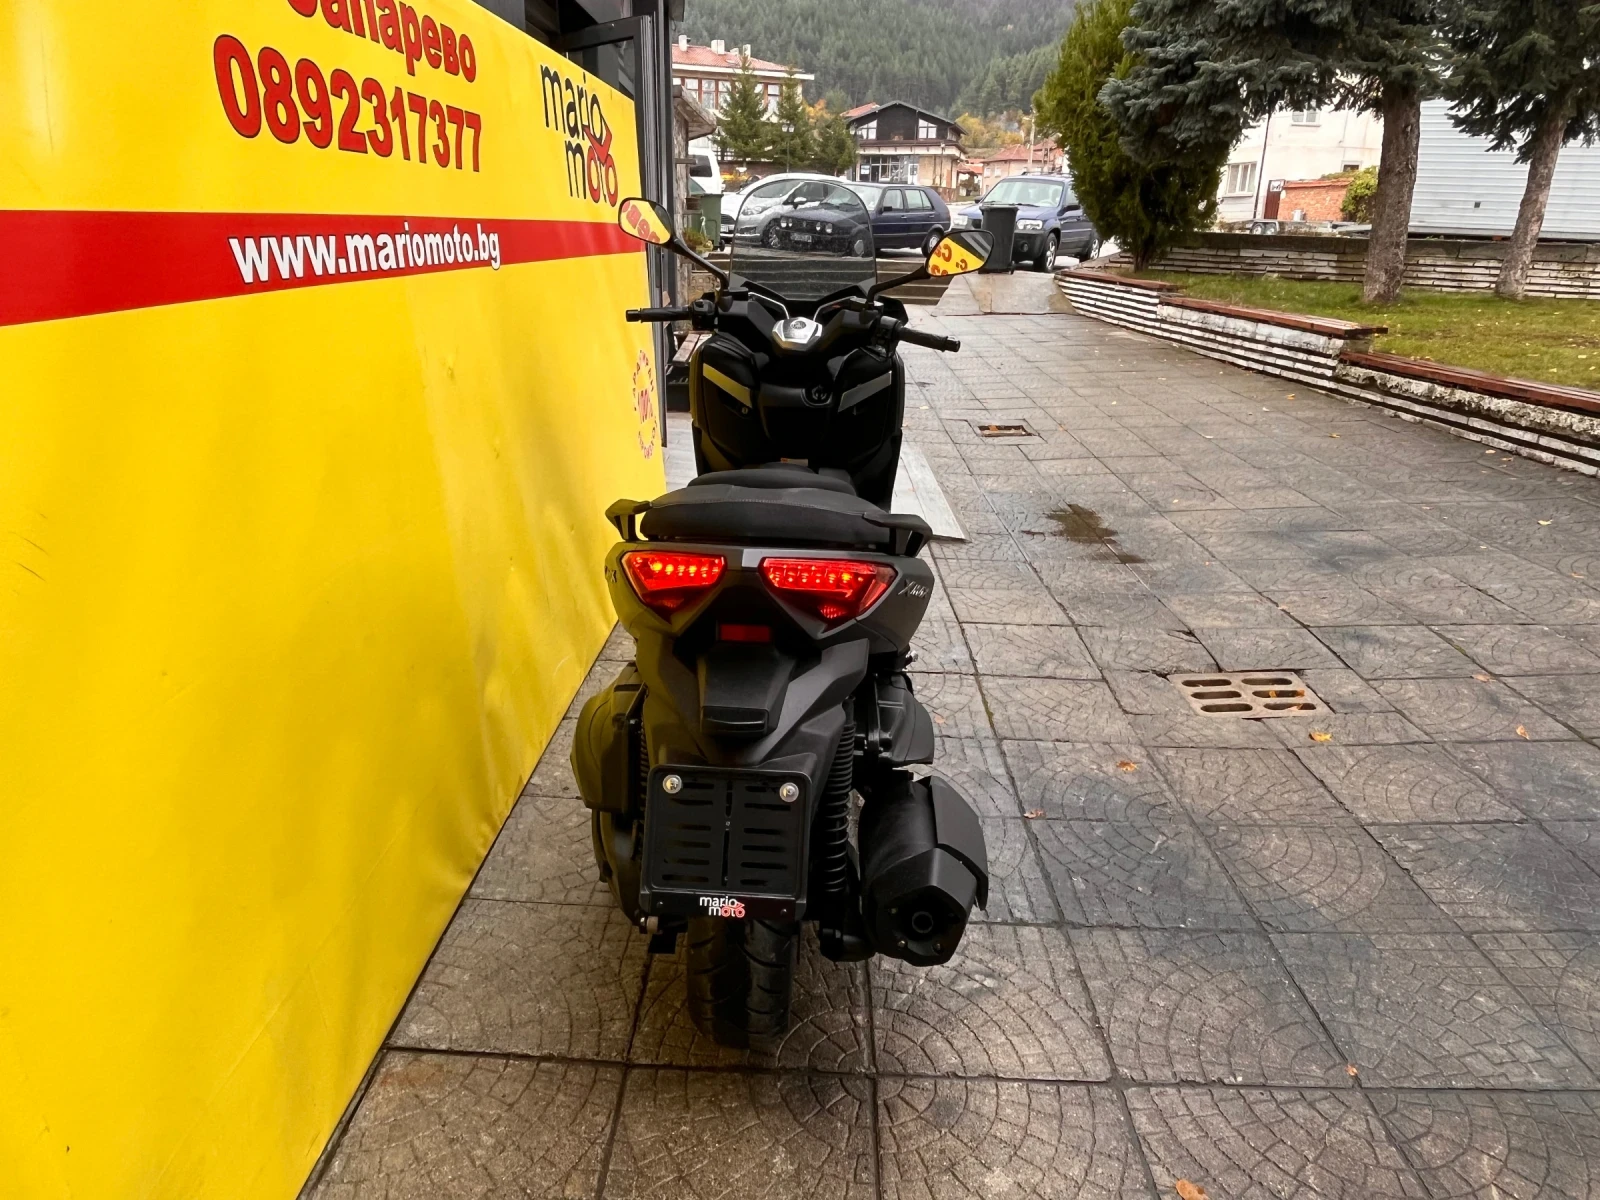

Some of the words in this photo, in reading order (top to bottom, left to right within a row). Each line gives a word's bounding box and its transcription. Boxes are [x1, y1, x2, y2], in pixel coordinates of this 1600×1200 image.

[287, 0, 477, 83] апарево
[213, 34, 482, 173] 0892317377
[540, 64, 606, 146] mario
[565, 140, 619, 208] moto
[228, 220, 501, 284] www.mariomoto.bg
[699, 895, 738, 907] mario
[708, 905, 746, 918] moto
